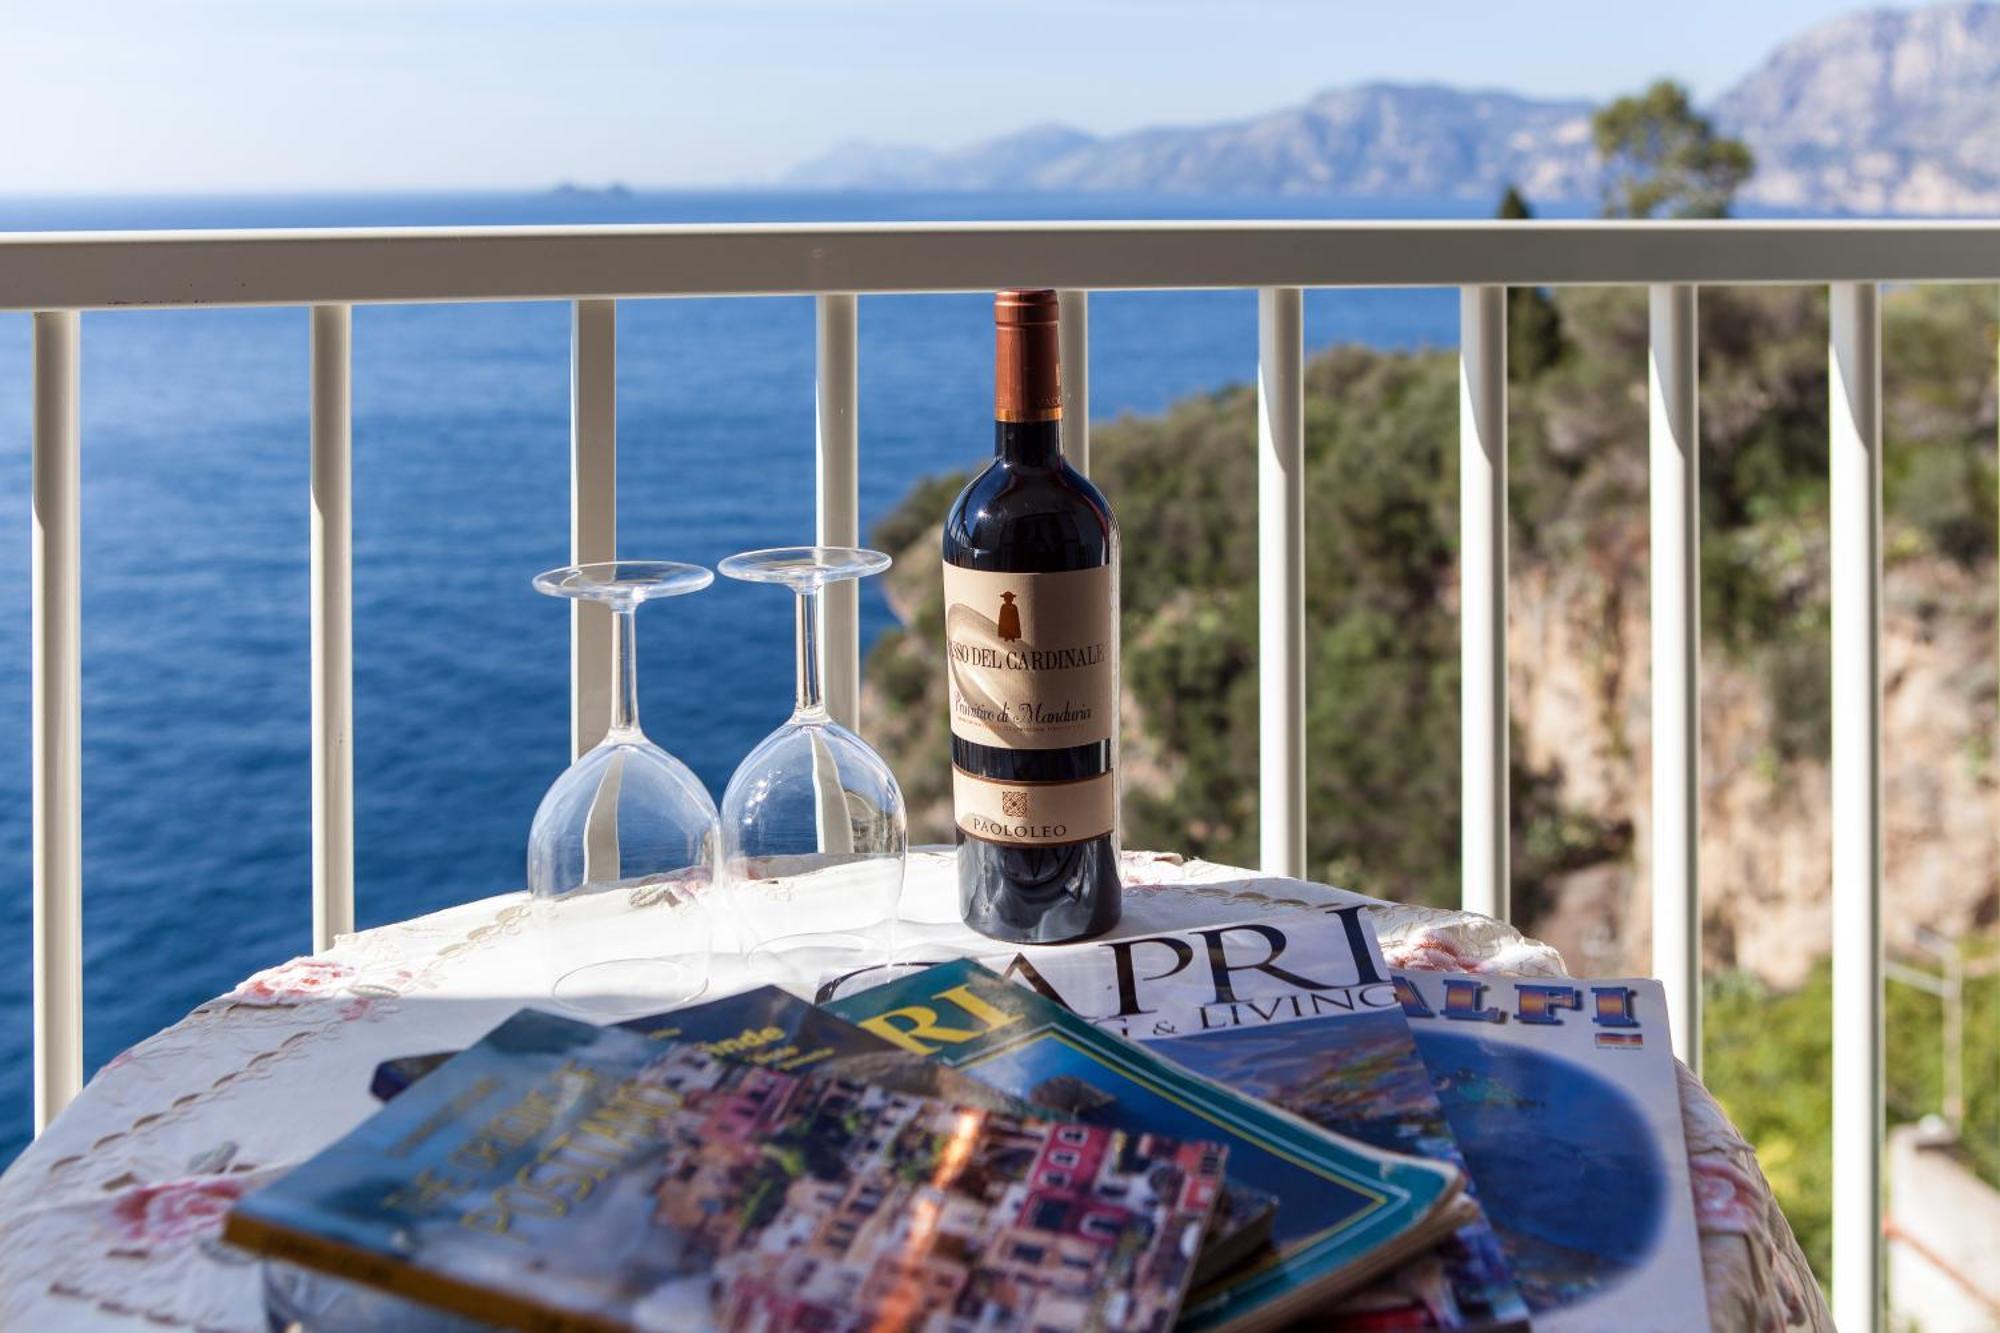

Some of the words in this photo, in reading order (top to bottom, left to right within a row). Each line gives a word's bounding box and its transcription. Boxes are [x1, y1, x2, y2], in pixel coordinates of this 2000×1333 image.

[972, 647, 1002, 669] DEL
[1006, 642, 1106, 671] CARDINALE
[997, 701, 1010, 723] di
[1013, 699, 1092, 724] Manduria
[1152, 1020, 1178, 1036] &
[1197, 983, 1397, 1030] LIVING
